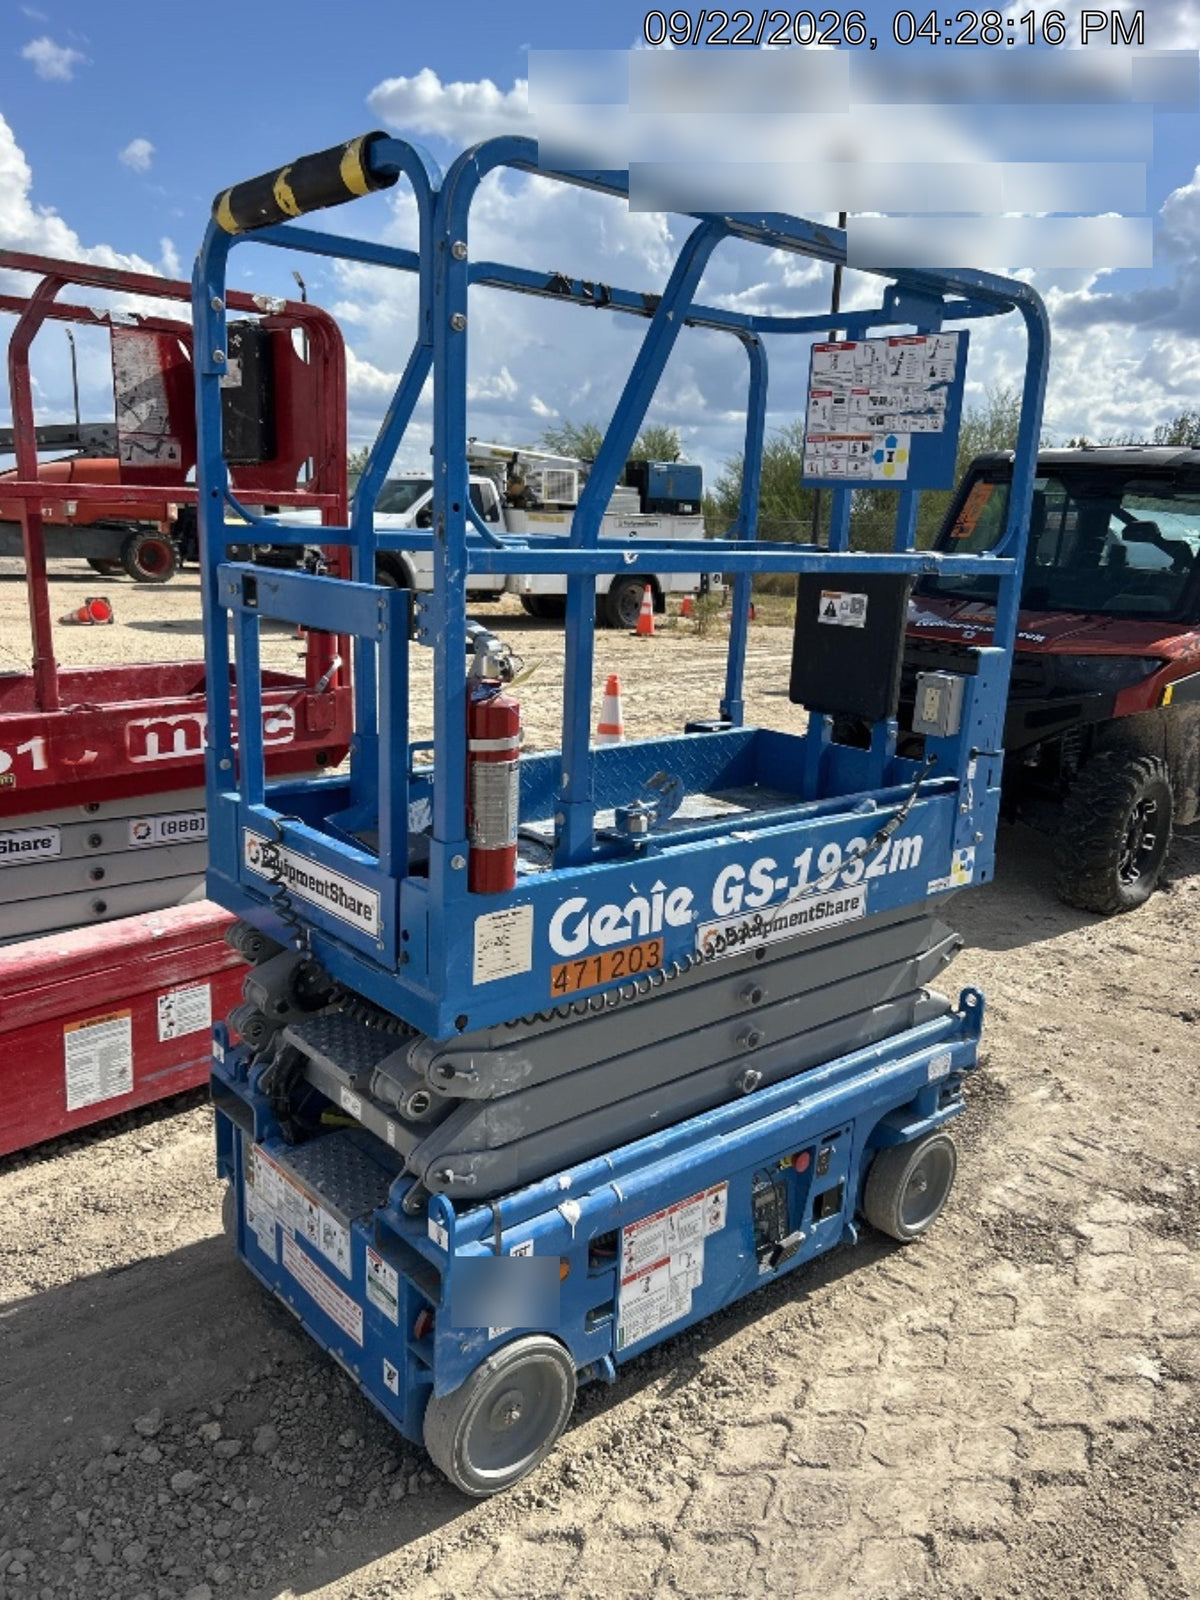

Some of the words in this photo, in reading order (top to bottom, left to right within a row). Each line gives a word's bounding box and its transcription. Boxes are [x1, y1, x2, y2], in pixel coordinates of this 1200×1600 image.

[129, 709, 295, 758] mc
[711, 834, 925, 917] GS-1932m
[548, 879, 694, 958] Genie
[552, 941, 661, 994] 471203
